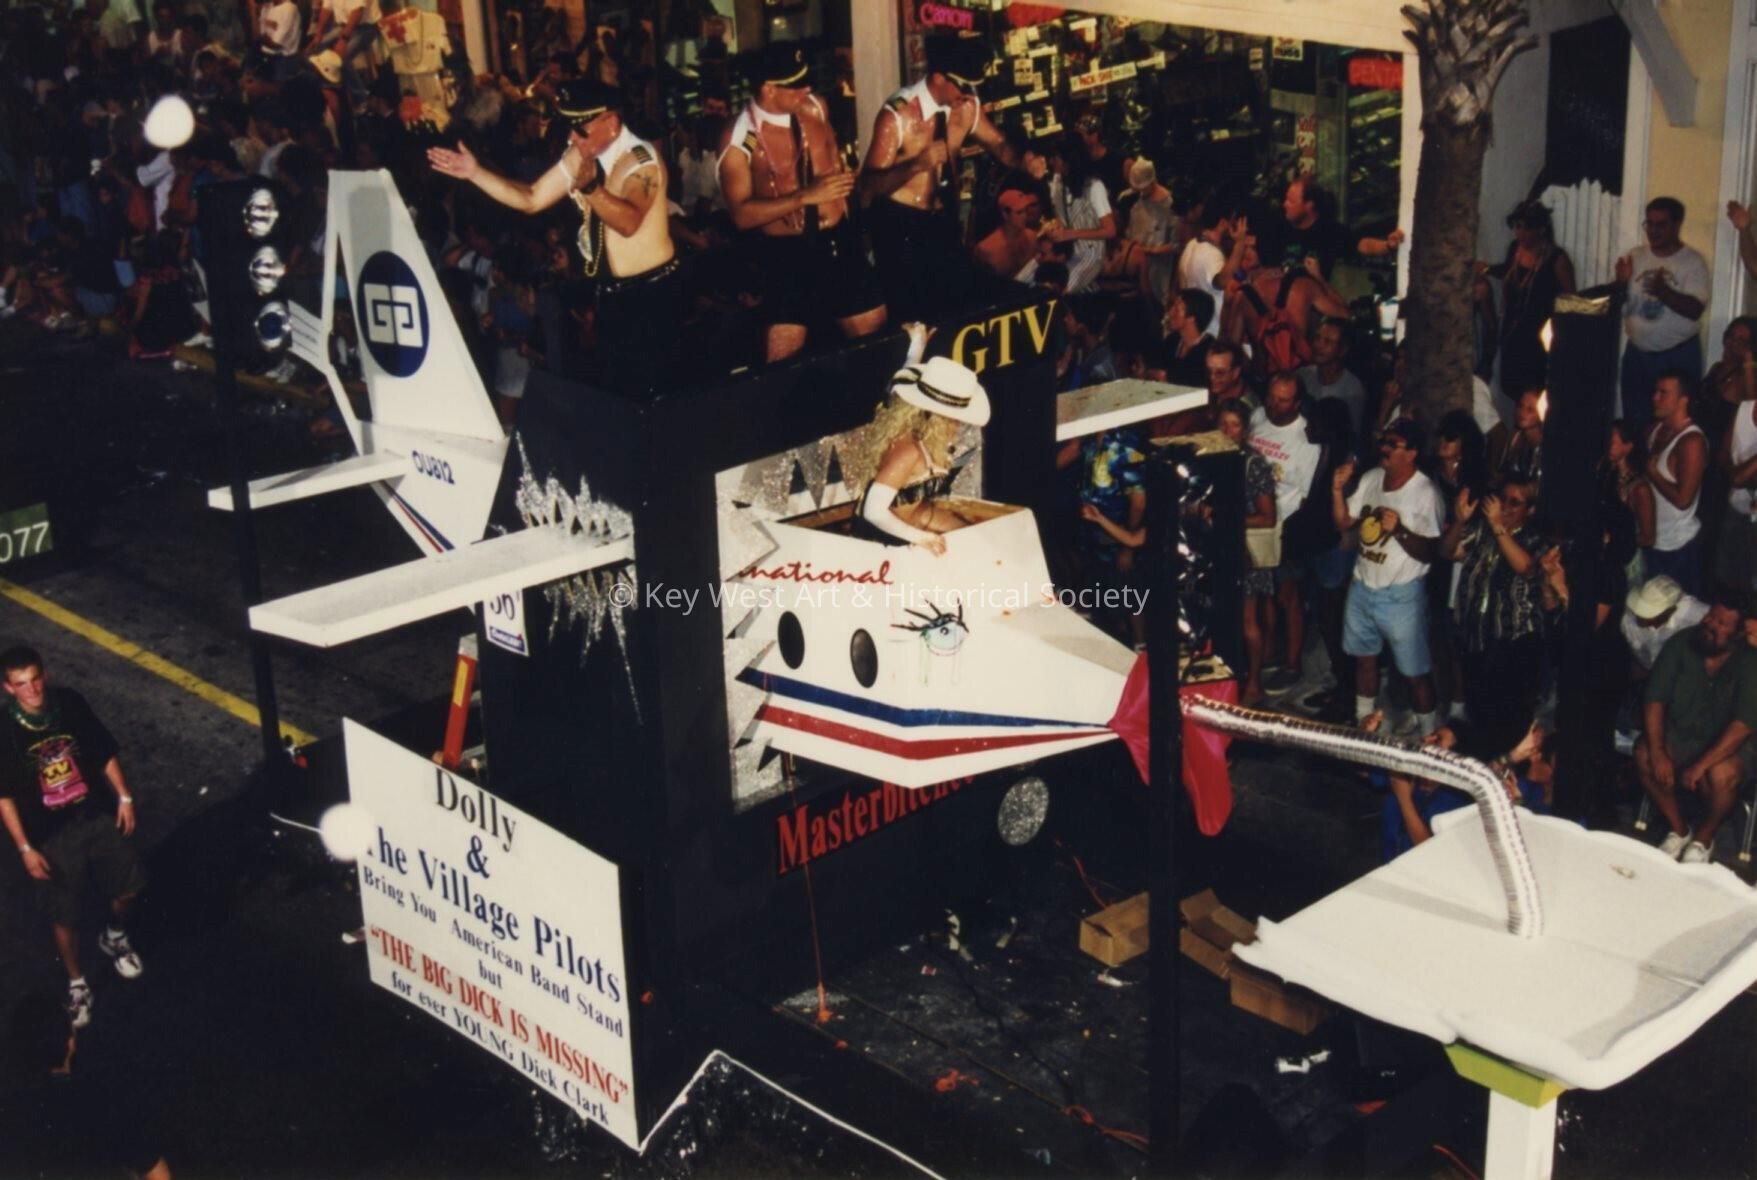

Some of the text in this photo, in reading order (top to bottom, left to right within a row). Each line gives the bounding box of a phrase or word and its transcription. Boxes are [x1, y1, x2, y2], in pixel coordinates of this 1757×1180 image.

[920, 2, 975, 30] Canon
[951, 299, 1058, 375] GTV
[411, 450, 455, 485] OU812
[435, 766, 517, 852] Dolly
[466, 835, 490, 878] &
[363, 865, 624, 1039] Bring You American Band Stand
[367, 825, 621, 1003] he Village Pilots
[421, 952, 454, 995] BIG
[459, 976, 505, 1029] DICK
[510, 1008, 530, 1044] IS
[478, 959, 504, 990] but
[391, 970, 610, 1128] for ever YOUNG Dick Clark
